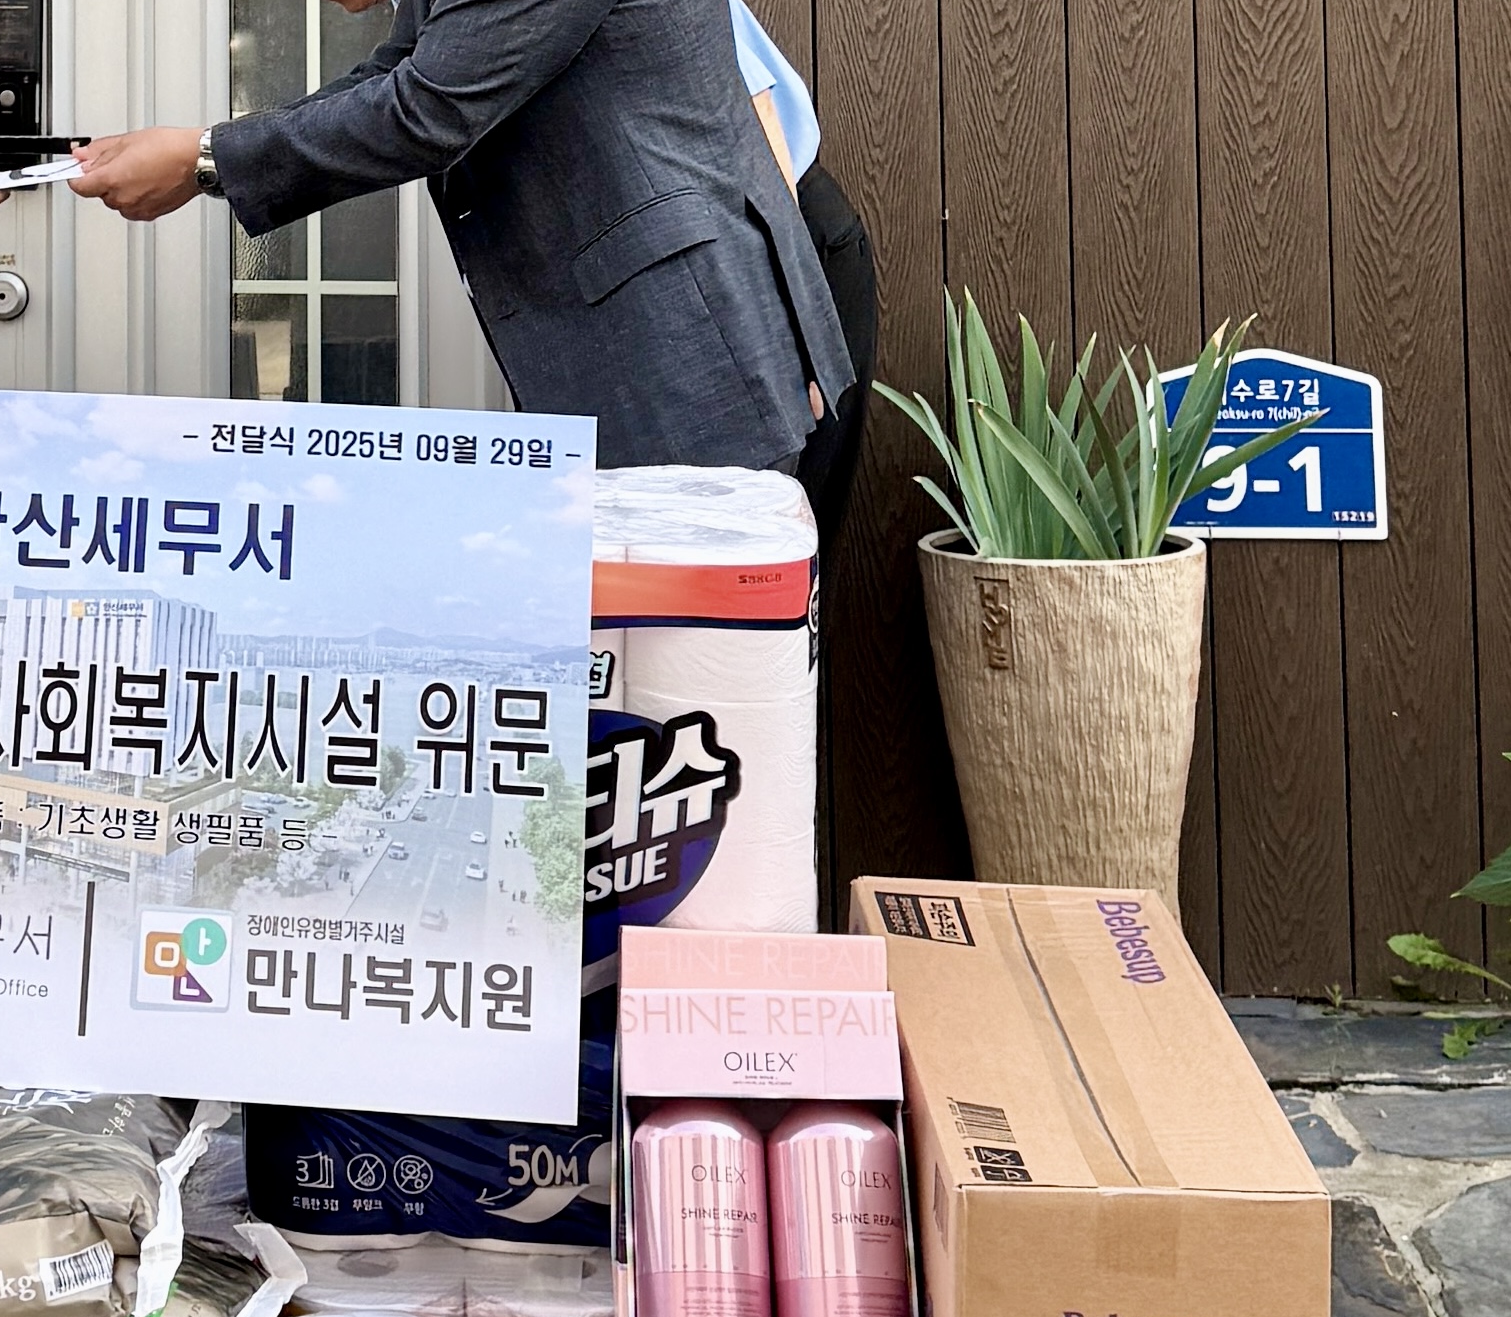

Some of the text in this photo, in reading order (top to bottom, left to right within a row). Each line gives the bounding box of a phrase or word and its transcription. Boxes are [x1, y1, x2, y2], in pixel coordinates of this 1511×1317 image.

[1221, 378, 1320, 405] 수로7길
[210, 423, 553, 468] 전달식 2025년 09월 29일
[1201, 445, 1323, 512] 9-1
[416, 681, 551, 797] 위문
[37, 801, 160, 841] 기초생활
[174, 811, 265, 848] 생필품
[280, 818, 308, 851] 등
[246, 914, 406, 945] 장애인유형별거주시설
[1096, 899, 1167, 984] Bebesup
[246, 948, 534, 1032] 만나복지원
[621, 995, 747, 1035] SHINE
[723, 1051, 796, 1073] OILEX
[508, 1144, 580, 1188] 50M
[691, 1164, 747, 1185] OILEX
[840, 1169, 892, 1190] OILEX
[681, 1208, 720, 1221] SHINE
[831, 1212, 870, 1225] SHINE
